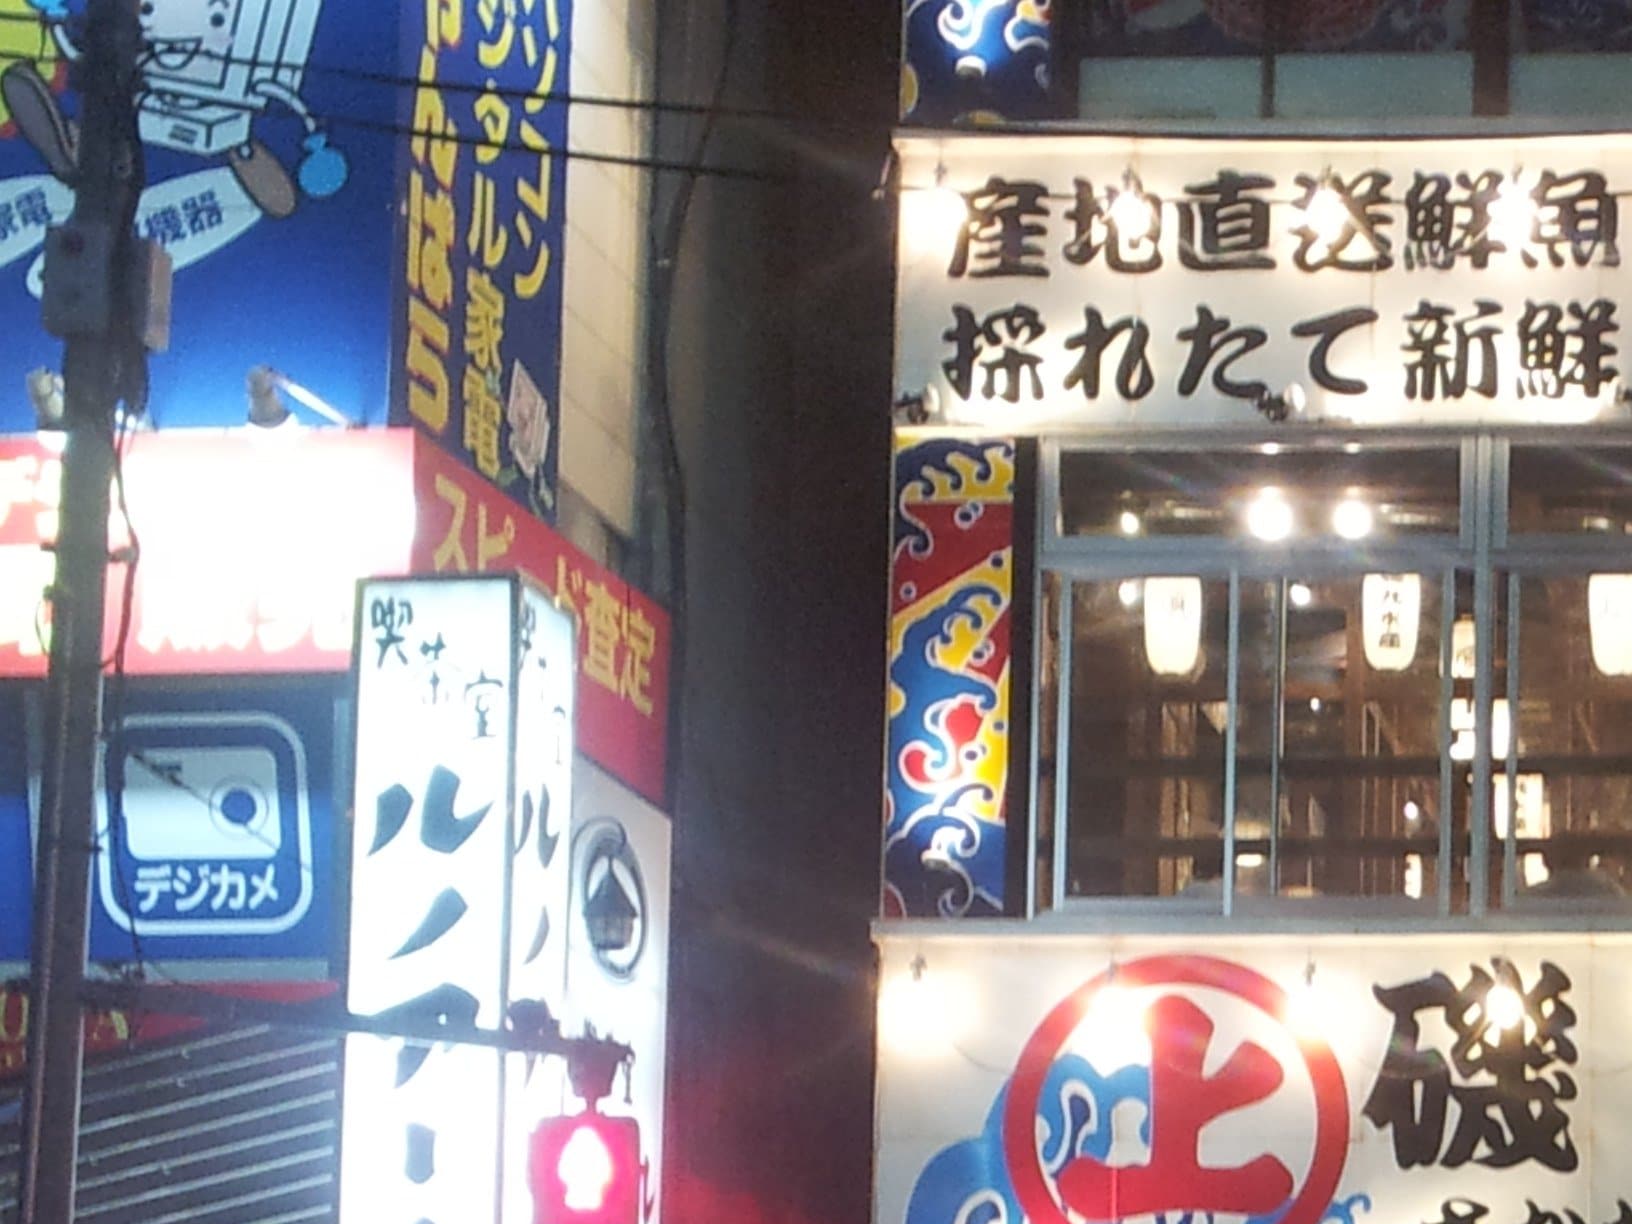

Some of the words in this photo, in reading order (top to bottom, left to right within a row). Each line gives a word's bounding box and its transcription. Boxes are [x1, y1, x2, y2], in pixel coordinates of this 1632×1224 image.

[945, 167, 1622, 280] 産地直送鮮魚
[941, 297, 1619, 403] 採れたて新鮮
[133, 866, 281, 914] デジカメ
